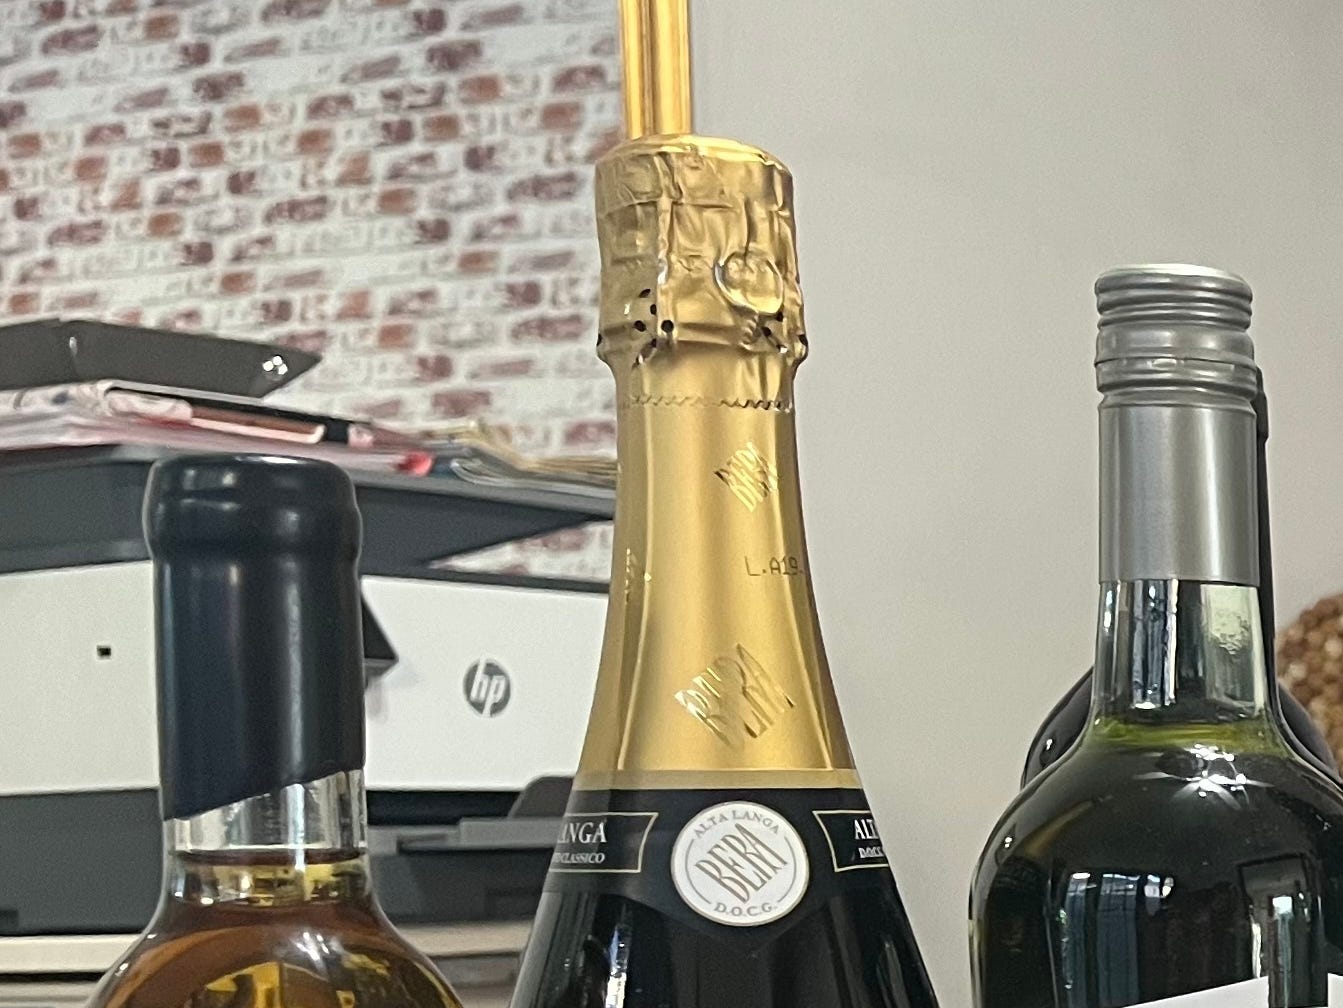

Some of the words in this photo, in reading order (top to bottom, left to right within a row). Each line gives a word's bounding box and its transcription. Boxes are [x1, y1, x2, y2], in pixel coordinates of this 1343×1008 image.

[466, 655, 508, 718] hp
[693, 811, 729, 839] ALTA
[732, 809, 781, 834] LANGA
[695, 822, 789, 904] BERA
[713, 900, 778, 918] D.O.C.G.
